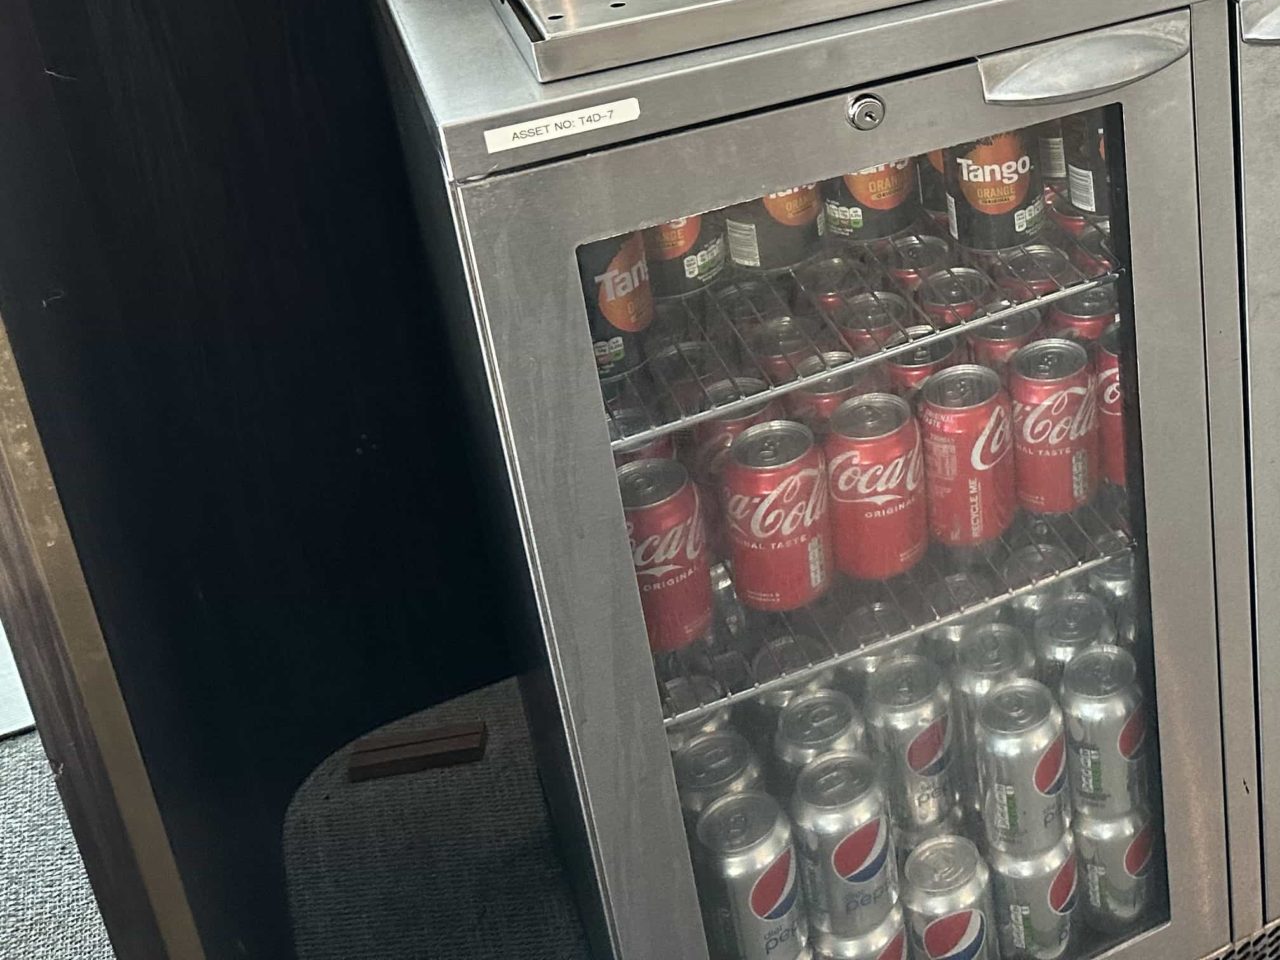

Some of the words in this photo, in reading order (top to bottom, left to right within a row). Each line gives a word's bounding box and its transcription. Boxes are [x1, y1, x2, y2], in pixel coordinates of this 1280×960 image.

[511, 125, 551, 142] ASSET
[554, 119, 576, 132] NO:
[578, 110, 615, 127] T4D-7
[956, 155, 1030, 185] Tango
[976, 185, 1016, 199] ORANGE
[1038, 446, 1072, 457] TASTE
[968, 477, 978, 496] ME
[969, 499, 981, 538] RECYCLE
[771, 534, 808, 550] TASTE
